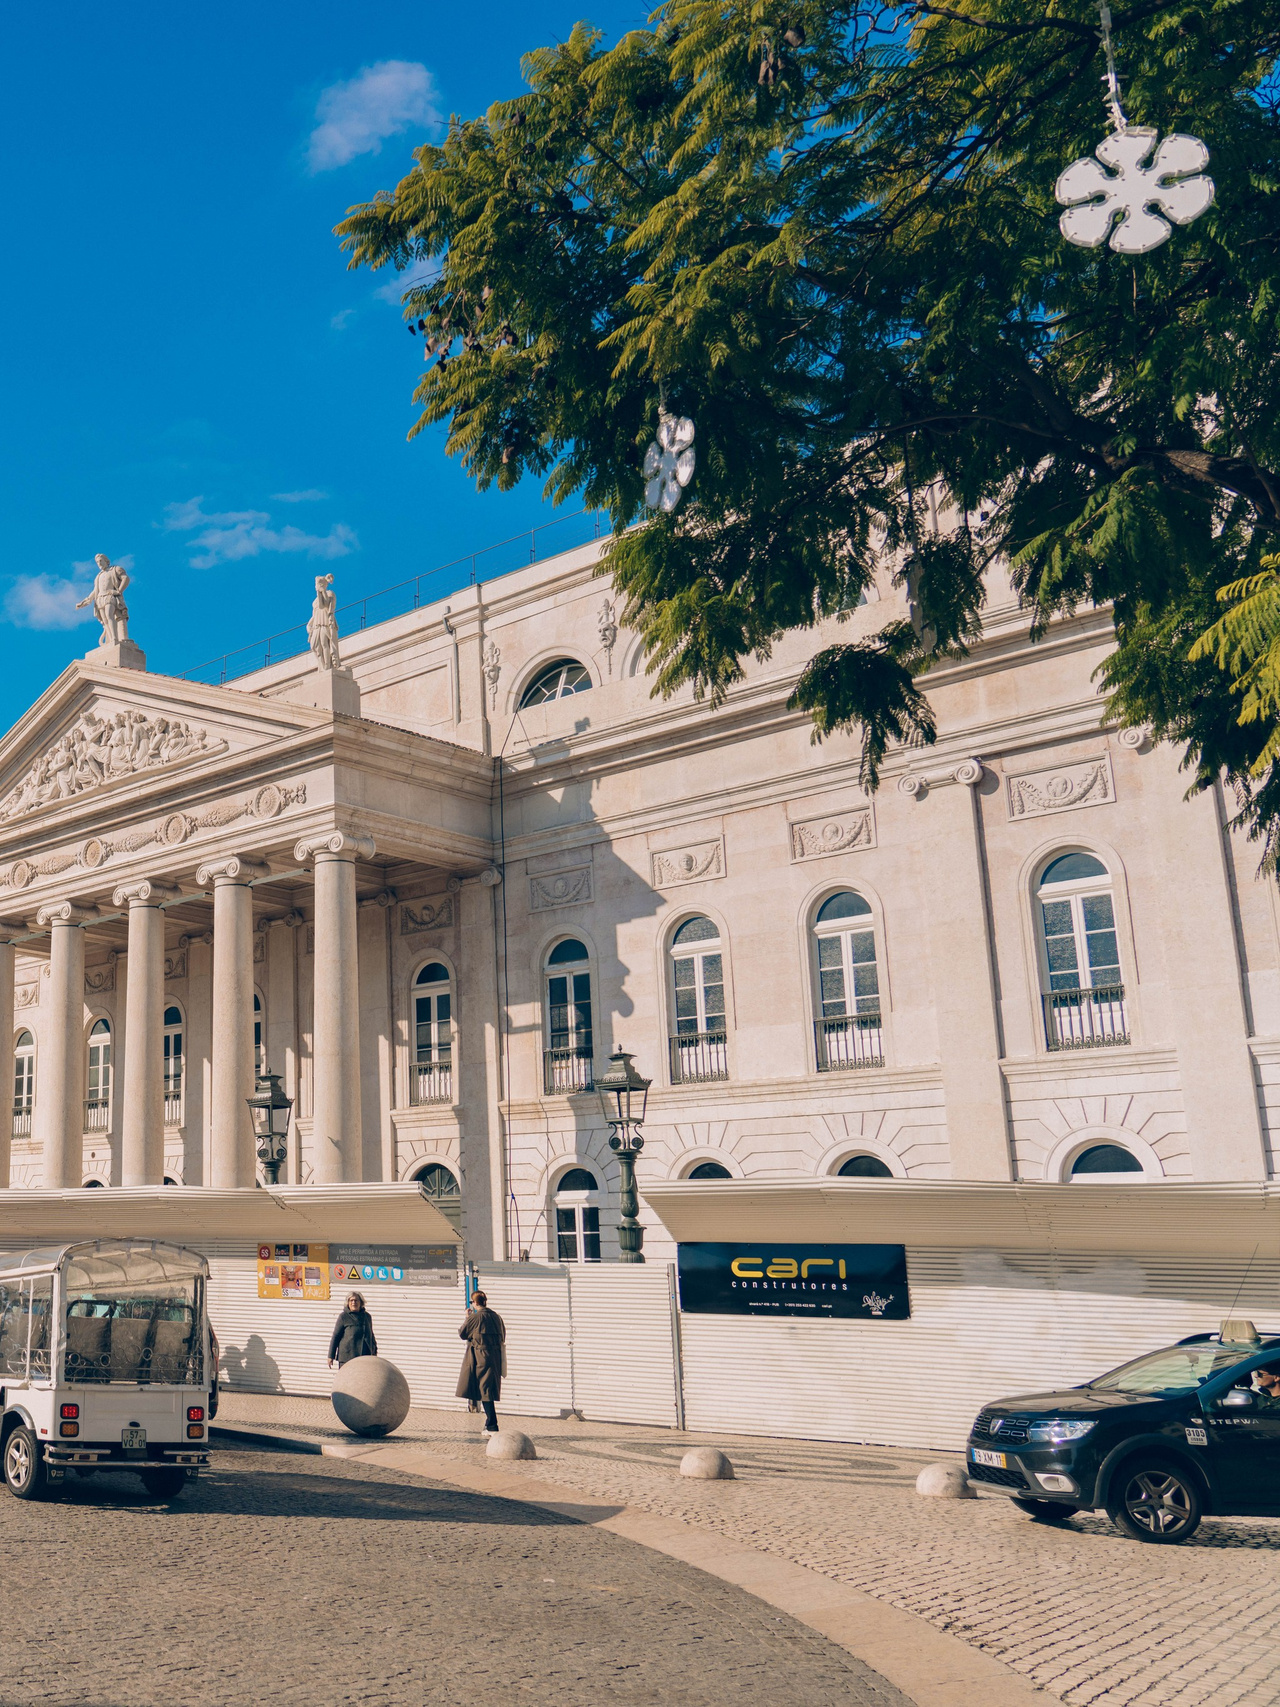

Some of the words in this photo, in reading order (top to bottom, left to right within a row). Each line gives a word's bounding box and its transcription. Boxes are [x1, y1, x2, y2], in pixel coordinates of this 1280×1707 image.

[261, 1249, 269, 1258] 5S
[731, 1257, 847, 1280] cari
[731, 1280, 848, 1291] construtores
[1186, 1429, 1206, 1438] 3105
